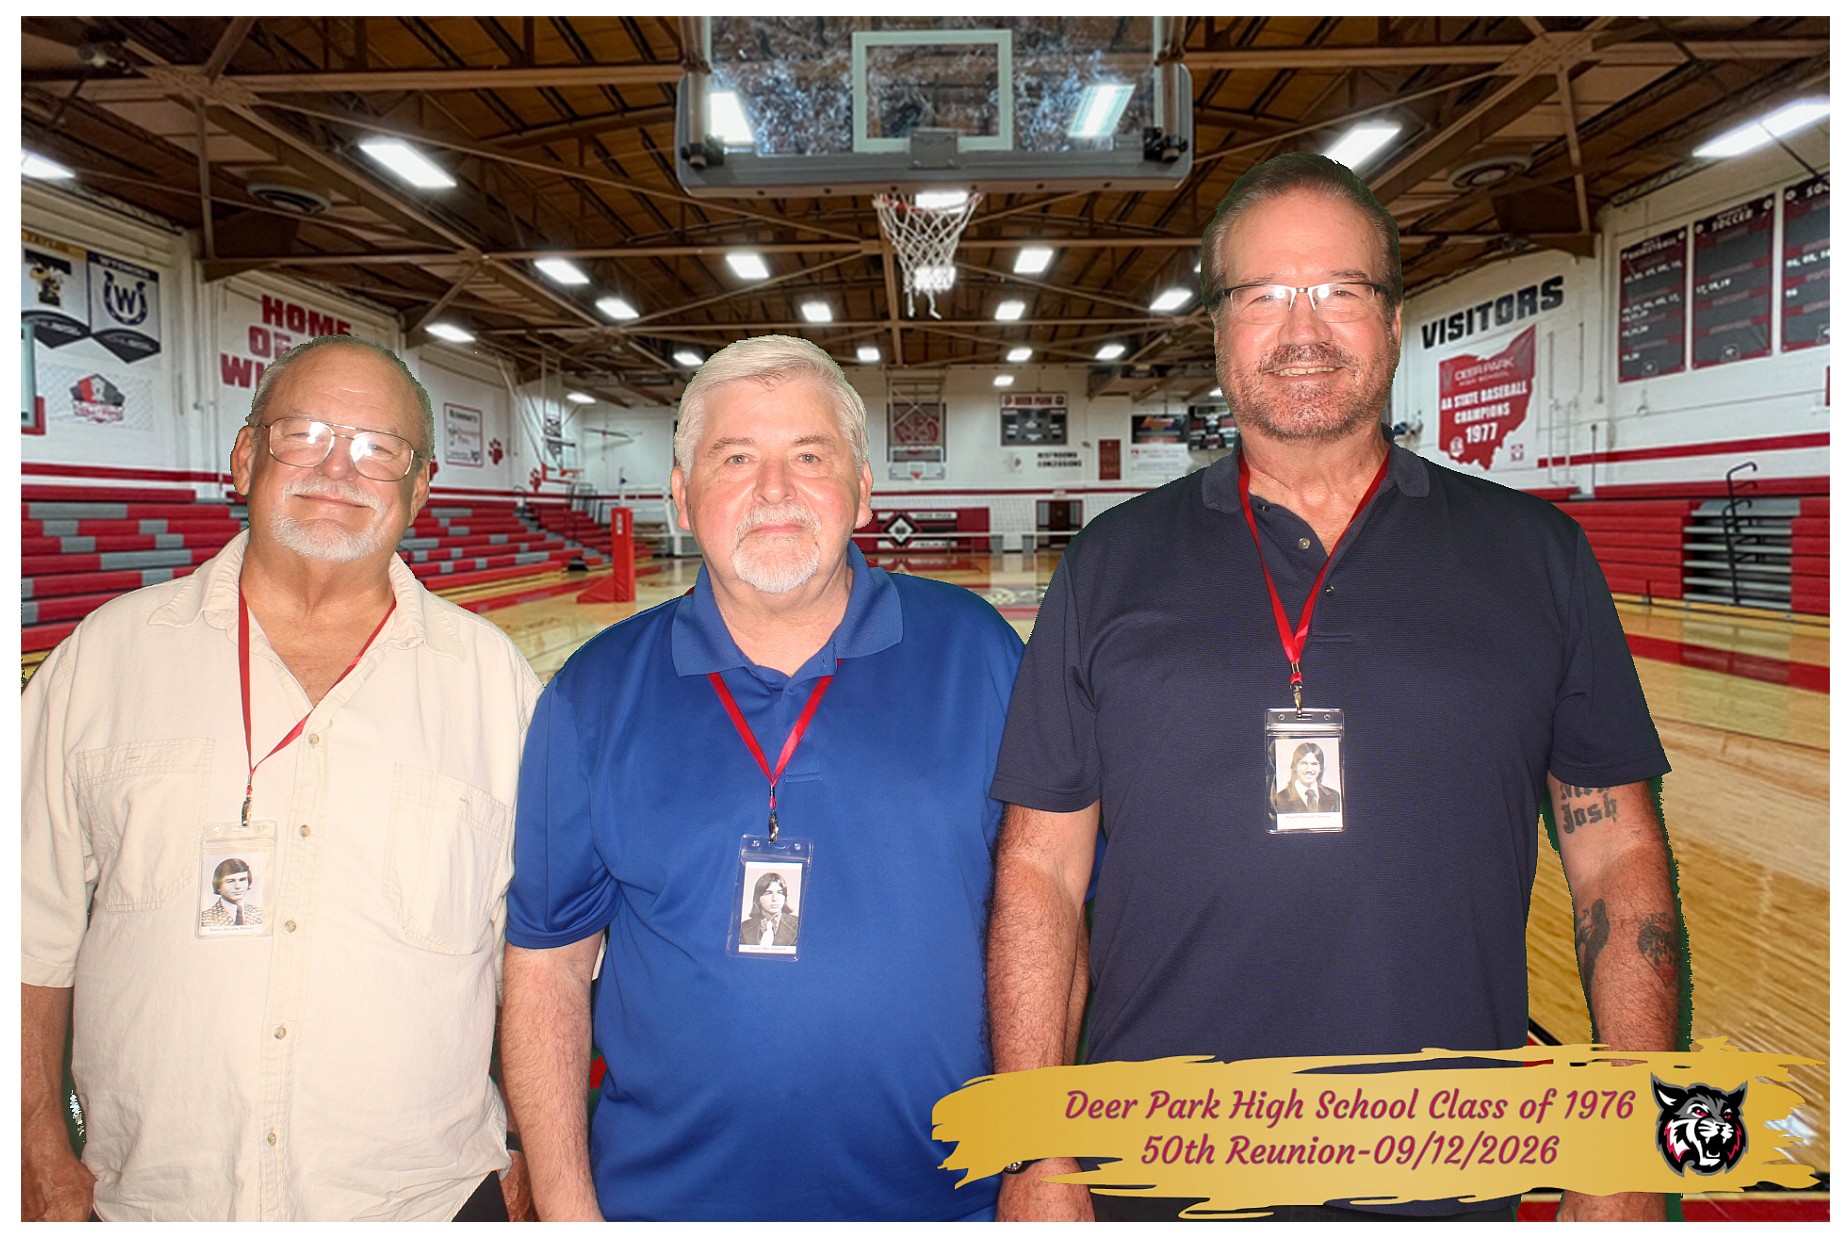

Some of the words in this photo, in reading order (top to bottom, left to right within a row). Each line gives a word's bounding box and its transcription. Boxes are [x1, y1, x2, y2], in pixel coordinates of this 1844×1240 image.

[1711, 210, 1753, 232] SOCCER
[262, 294, 352, 337] HOME
[1421, 275, 1564, 350] VISITORS
[249, 325, 292, 360] OF
[1483, 356, 1515, 373] PARK
[1441, 397, 1453, 411] AA
[1454, 390, 1479, 408] STATE
[1480, 380, 1529, 403] BASEBALL
[1454, 402, 1511, 425] CHAMPIONS
[1465, 422, 1499, 444] 1977
[1561, 792, 1618, 834] Josh
